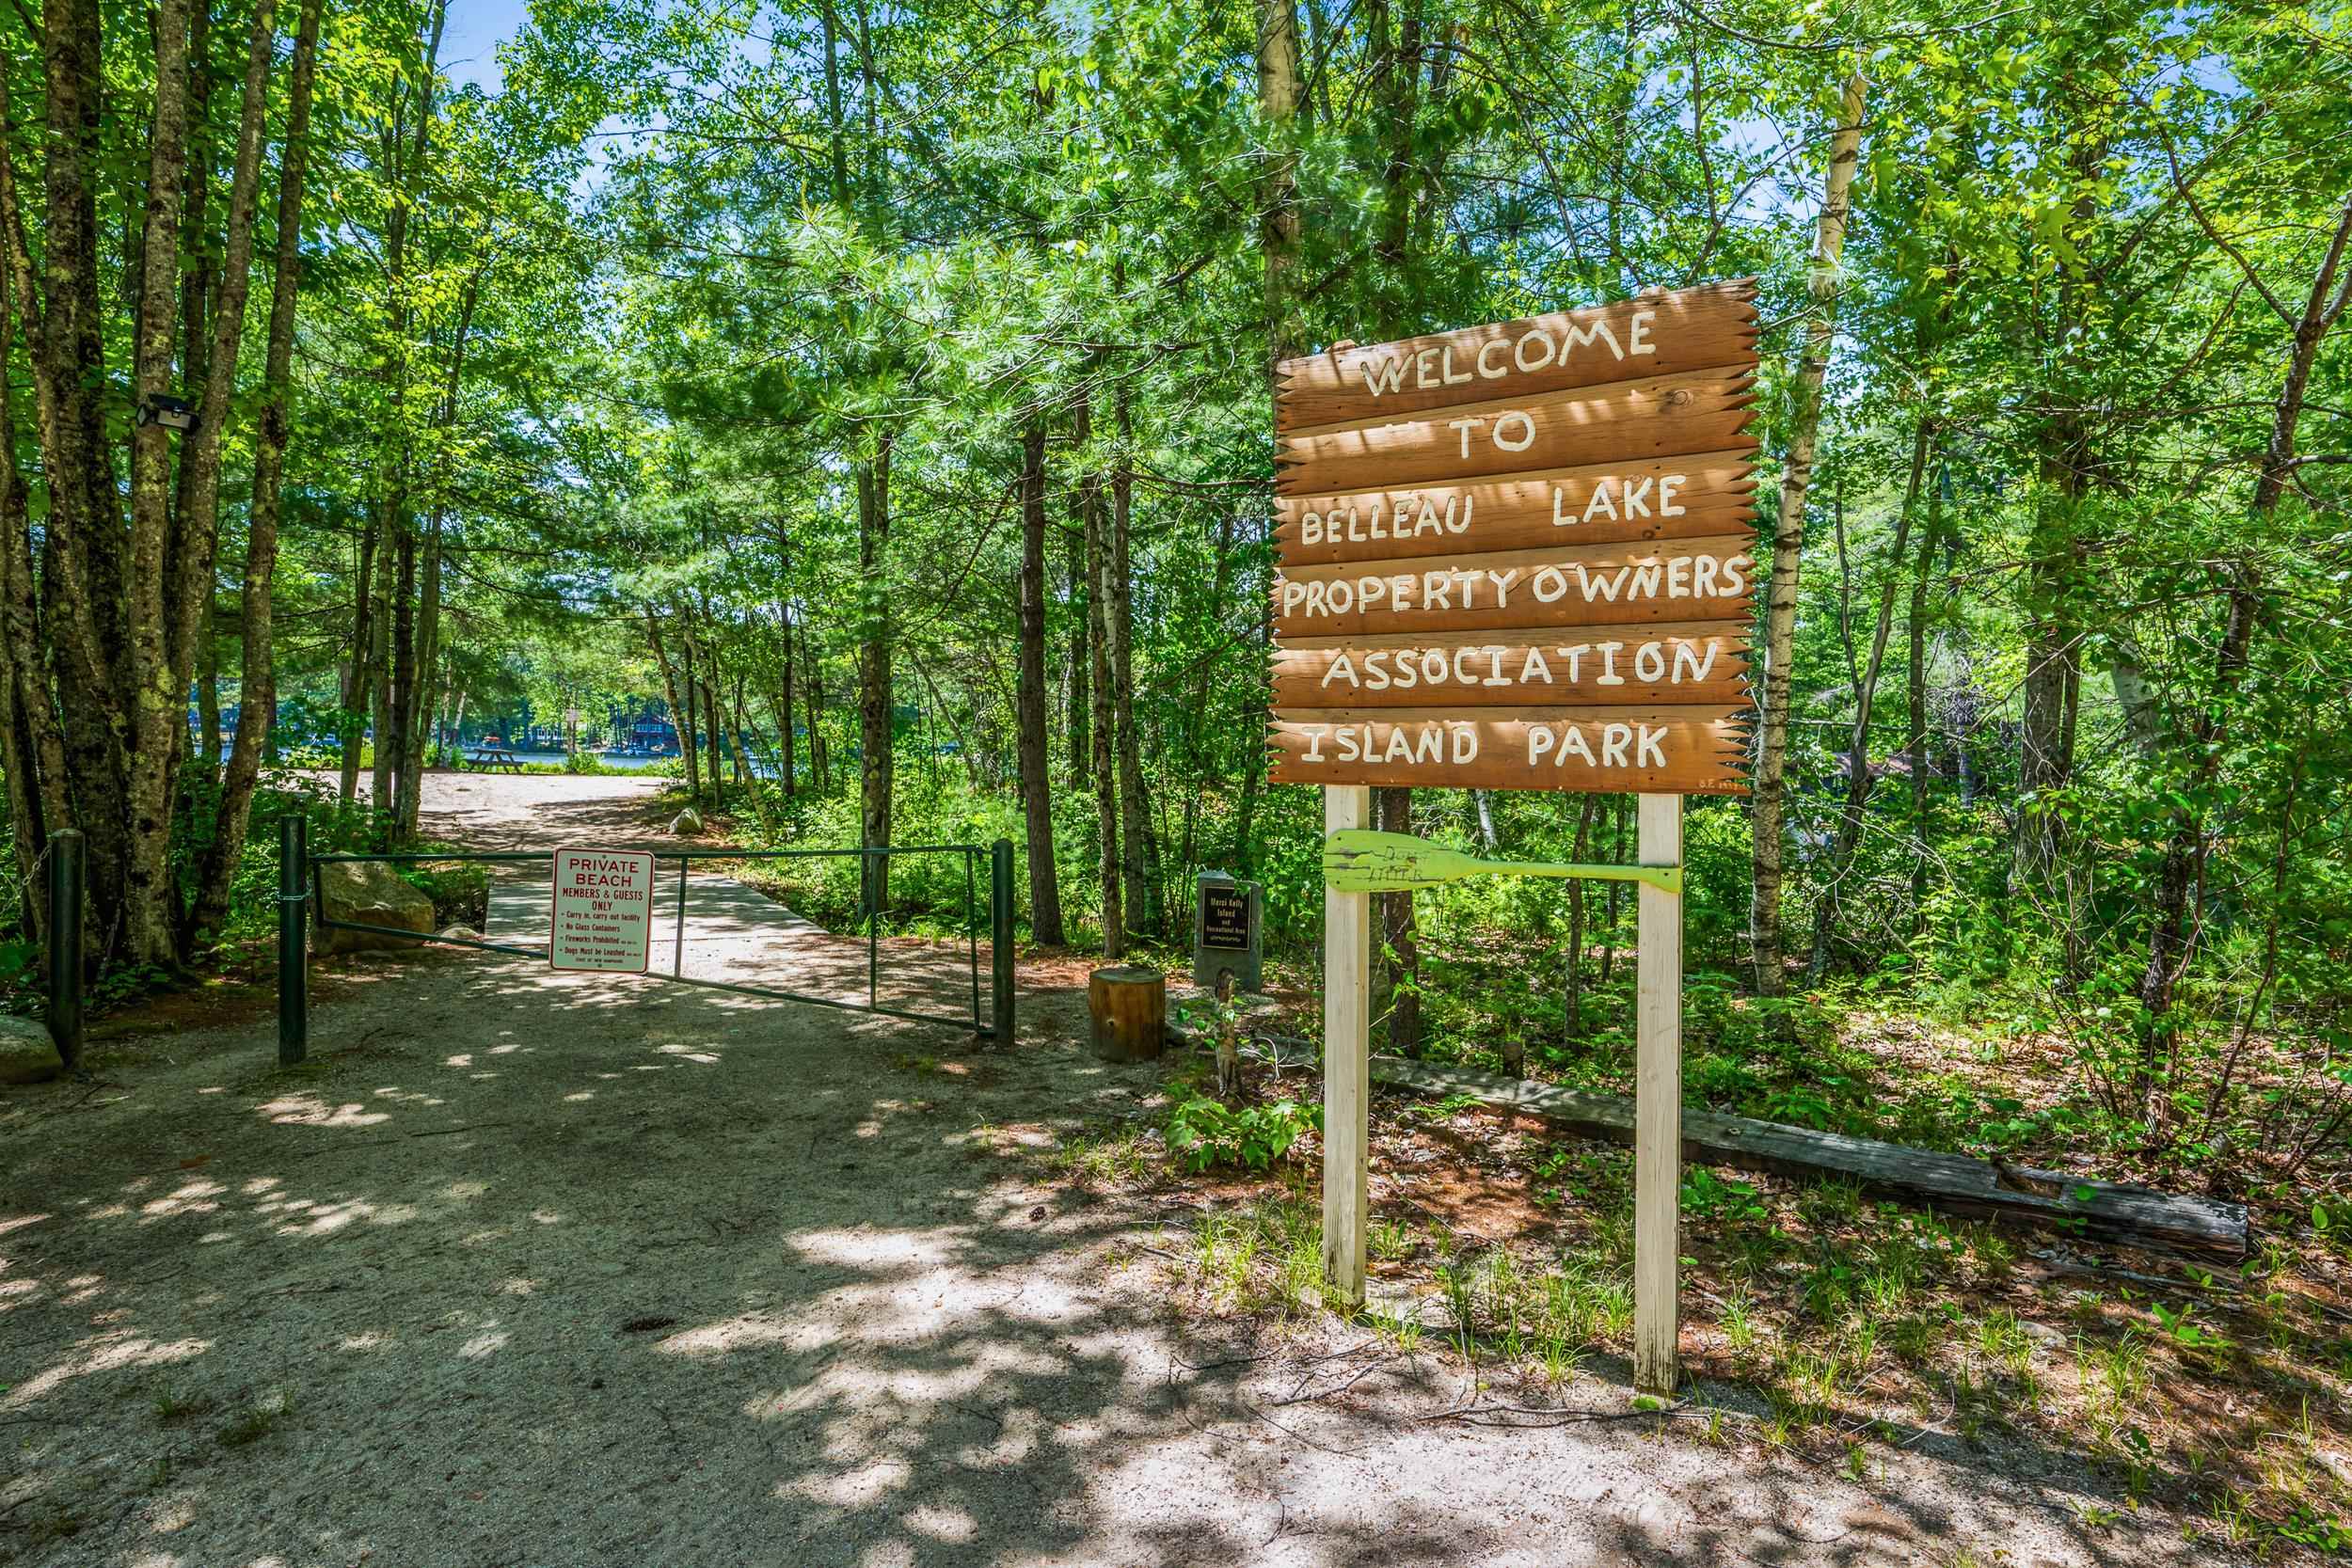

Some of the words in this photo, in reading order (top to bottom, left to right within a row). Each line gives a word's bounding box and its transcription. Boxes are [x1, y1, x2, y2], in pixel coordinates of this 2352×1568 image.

[1360, 311, 1657, 397] WELCOME
[1450, 410, 1536, 459] TO
[1301, 494, 1473, 546] BELLEAU
[1552, 475, 1687, 527] LAKE
[1283, 569, 1516, 618] PROPERTY
[1533, 554, 1747, 603] OWNERS
[1322, 641, 1717, 690] ASSOCIATION
[1301, 725, 1479, 765] ISLAND
[1528, 722, 1670, 768] PARK
[569, 858, 639, 873] PRIVATE
[576, 873, 632, 887] BEACH
[563, 887, 600, 898] MEMBERS
[603, 890, 610, 898] &
[613, 890, 644, 901] GUESTS
[592, 901, 612, 911] ONLY
[566, 911, 581, 920] Carry
[593, 912, 608, 921] carry
[621, 913, 641, 923] facility
[575, 923, 590, 931] Glass
[592, 924, 621, 932] Containers
[564, 934, 591, 942] Fireworks
[593, 935, 619, 944] Prohibited
[564, 946, 578, 956] Dogs
